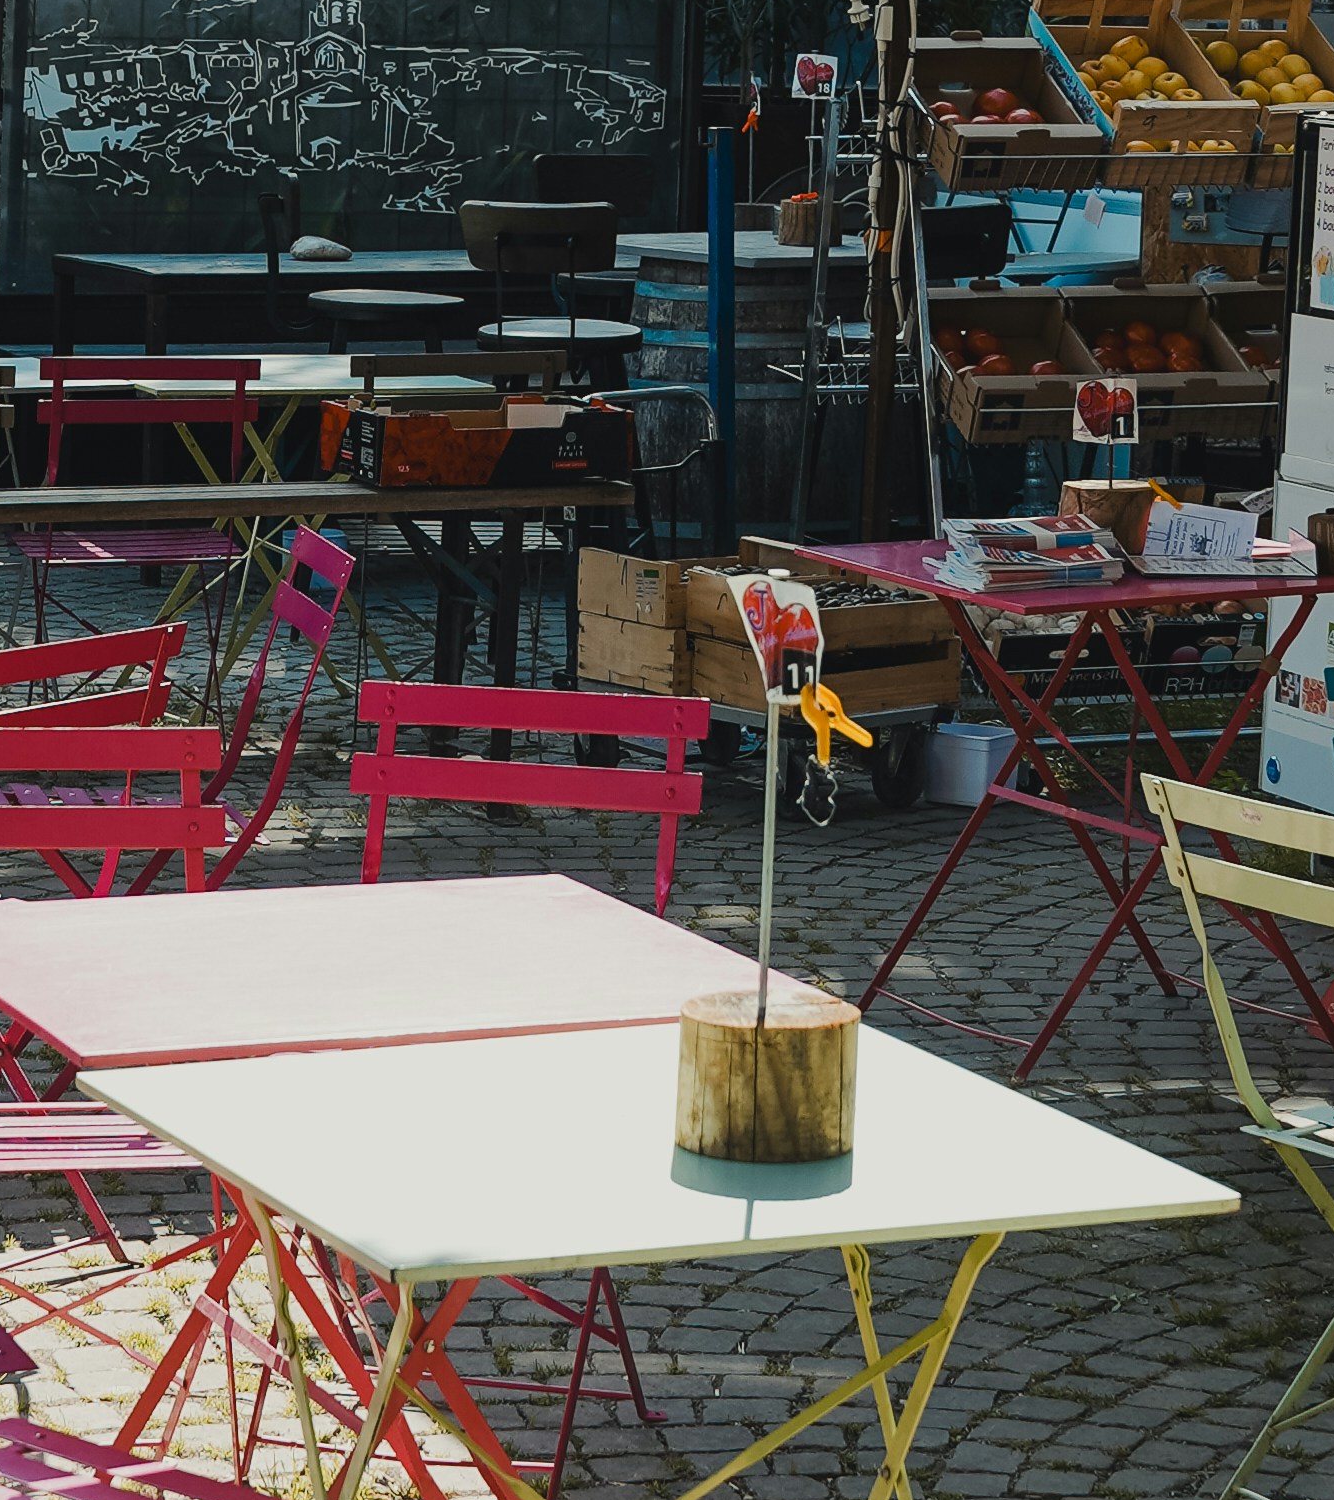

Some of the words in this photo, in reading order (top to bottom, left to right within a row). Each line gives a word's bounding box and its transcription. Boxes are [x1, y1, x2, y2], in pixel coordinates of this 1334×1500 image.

[817, 82, 830, 94] 18
[1116, 416, 1126, 436] 1
[786, 662, 815, 691] 11
[1164, 676, 1205, 693] RPH
